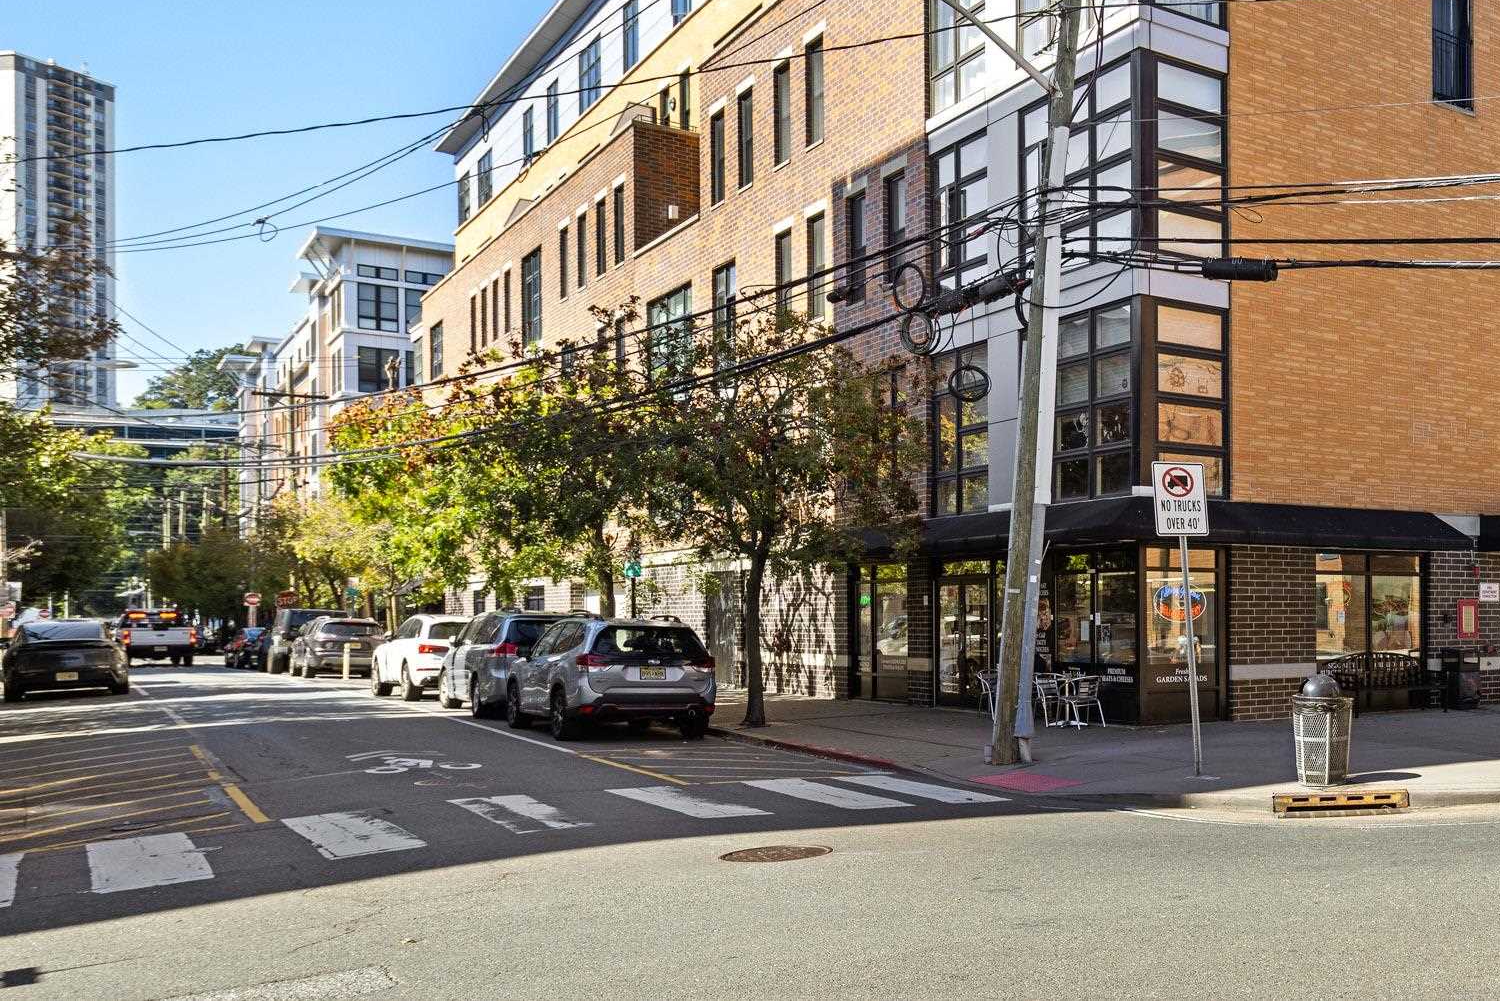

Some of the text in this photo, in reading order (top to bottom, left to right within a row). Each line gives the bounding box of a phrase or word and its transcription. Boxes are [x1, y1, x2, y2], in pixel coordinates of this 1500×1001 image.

[1161, 500, 1202, 512] NO TRUCKS
[1166, 517, 1200, 530] OVER 40'
[1184, 675, 1208, 683] SAADS
